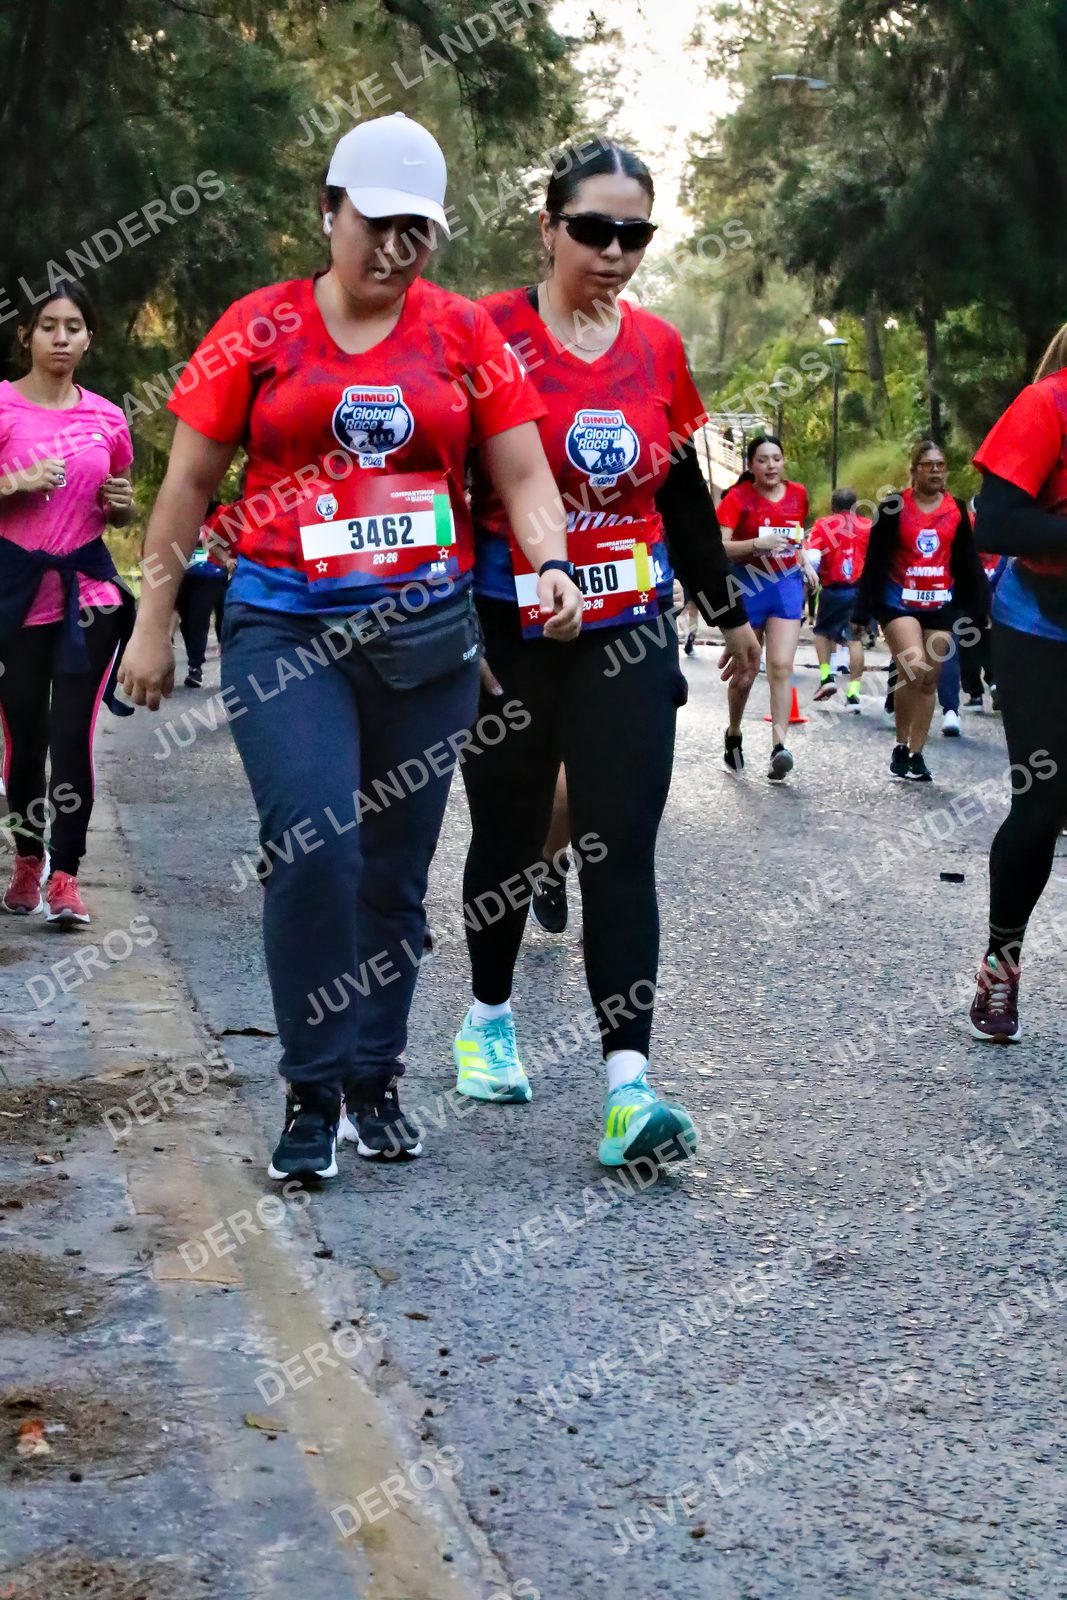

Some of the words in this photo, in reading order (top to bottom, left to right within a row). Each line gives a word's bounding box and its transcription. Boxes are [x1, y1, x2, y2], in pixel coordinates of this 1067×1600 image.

[351, 393, 395, 402] BIMBO
[352, 407, 395, 420] Global
[344, 419, 378, 430] Race
[582, 416, 619, 424] BIMBO
[585, 428, 620, 440] Global
[578, 439, 608, 450] Race
[362, 456, 383, 466] 2026
[348, 516, 415, 549] 3462
[430, 562, 446, 572] 5K
[575, 564, 619, 595] 460
[633, 605, 647, 615] 5K
